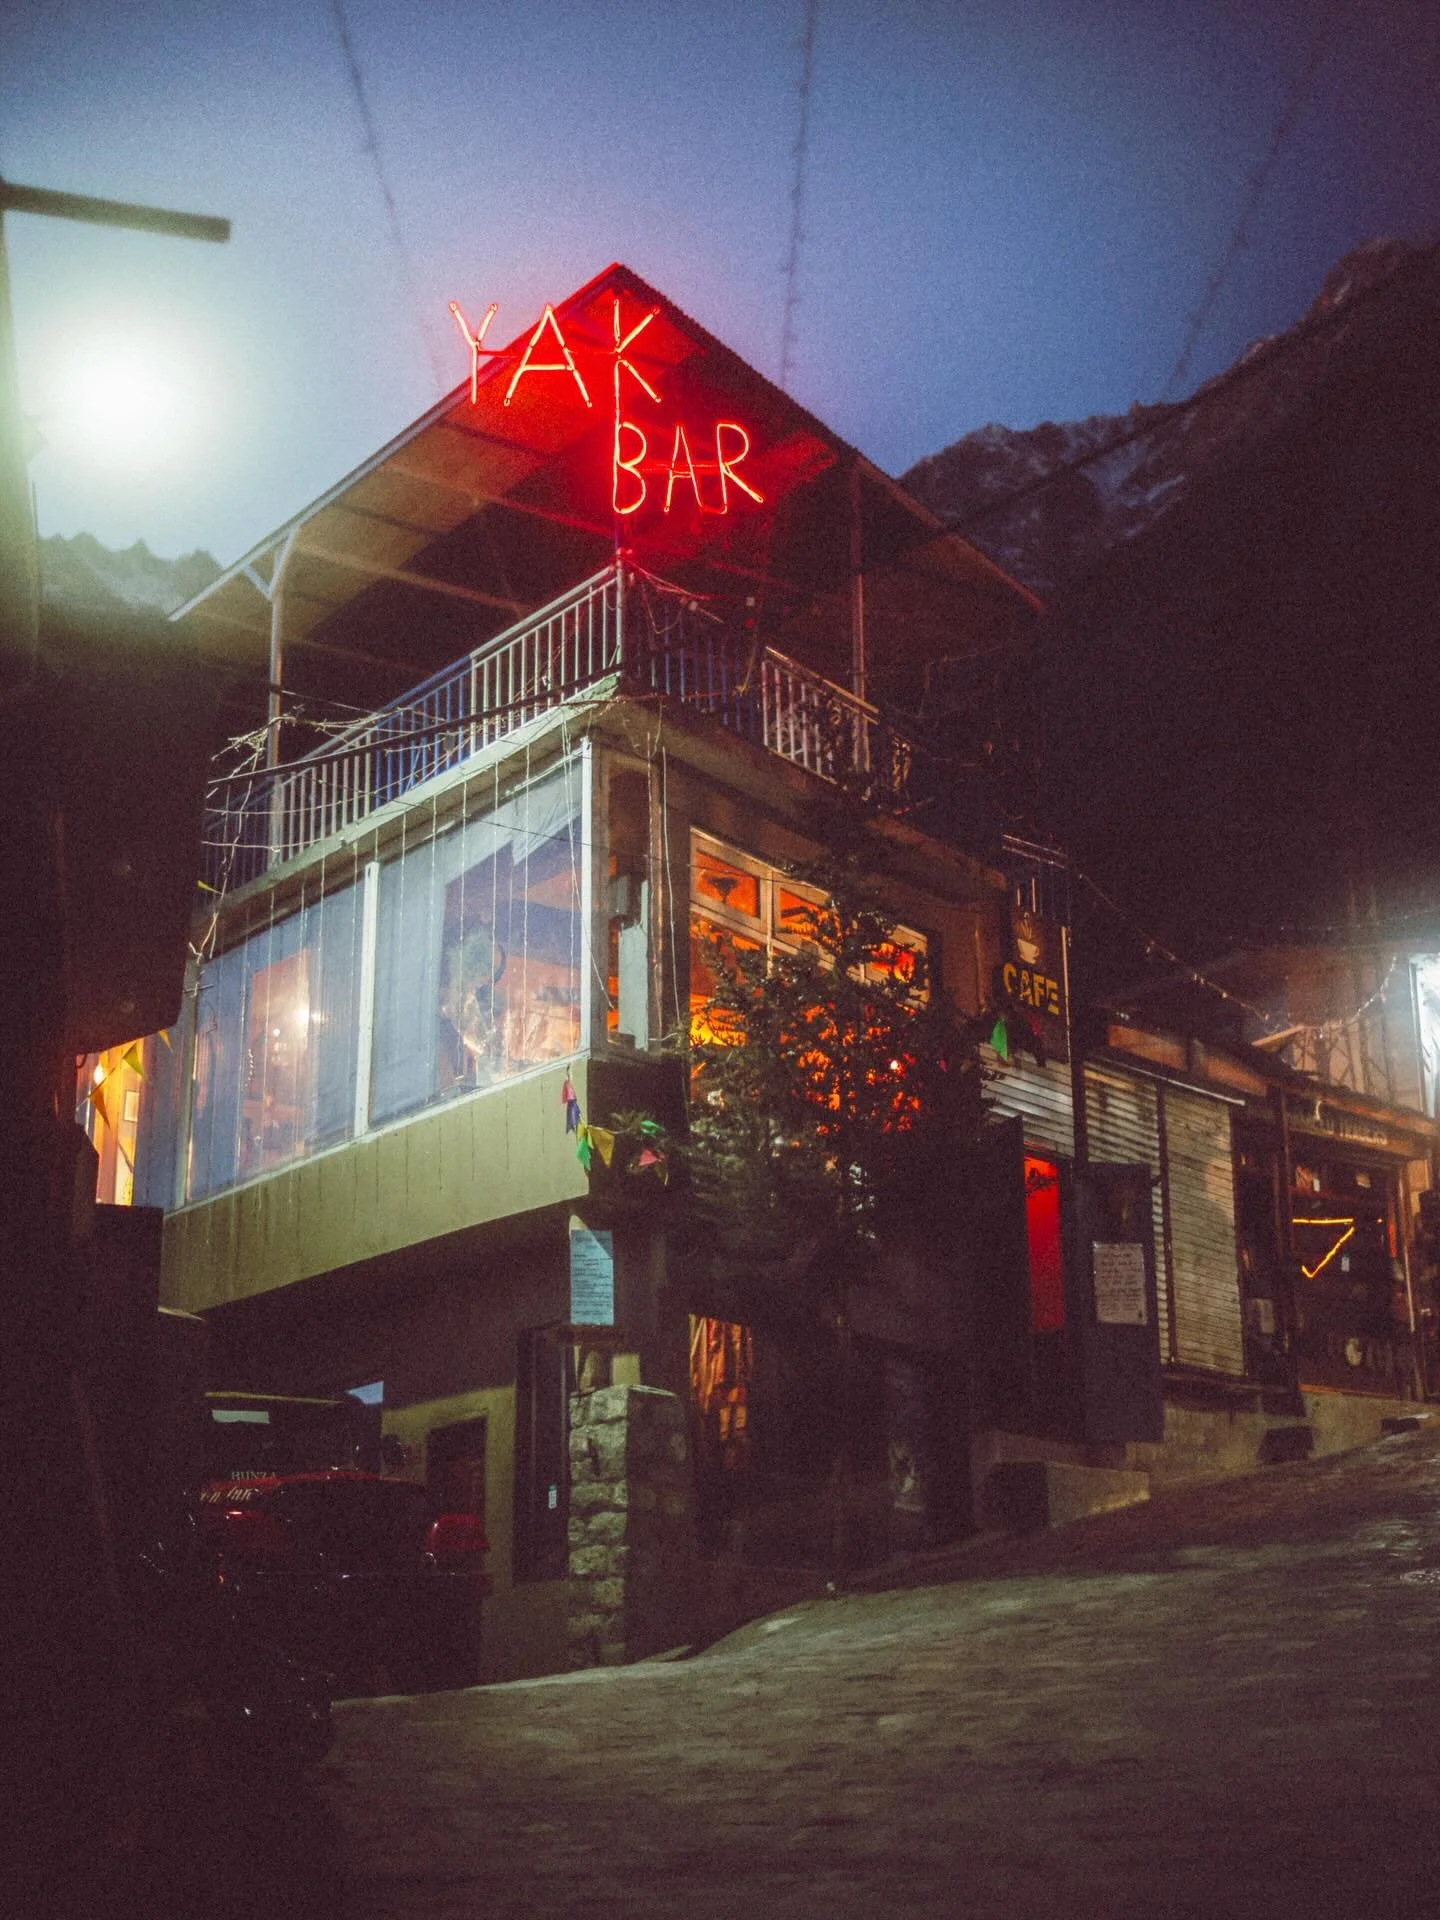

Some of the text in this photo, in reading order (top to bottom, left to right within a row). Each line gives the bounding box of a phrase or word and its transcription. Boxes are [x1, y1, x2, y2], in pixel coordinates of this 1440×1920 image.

[450, 299, 663, 408] YAK
[612, 421, 764, 515] BAR
[1003, 962, 1060, 1016] CAFE
